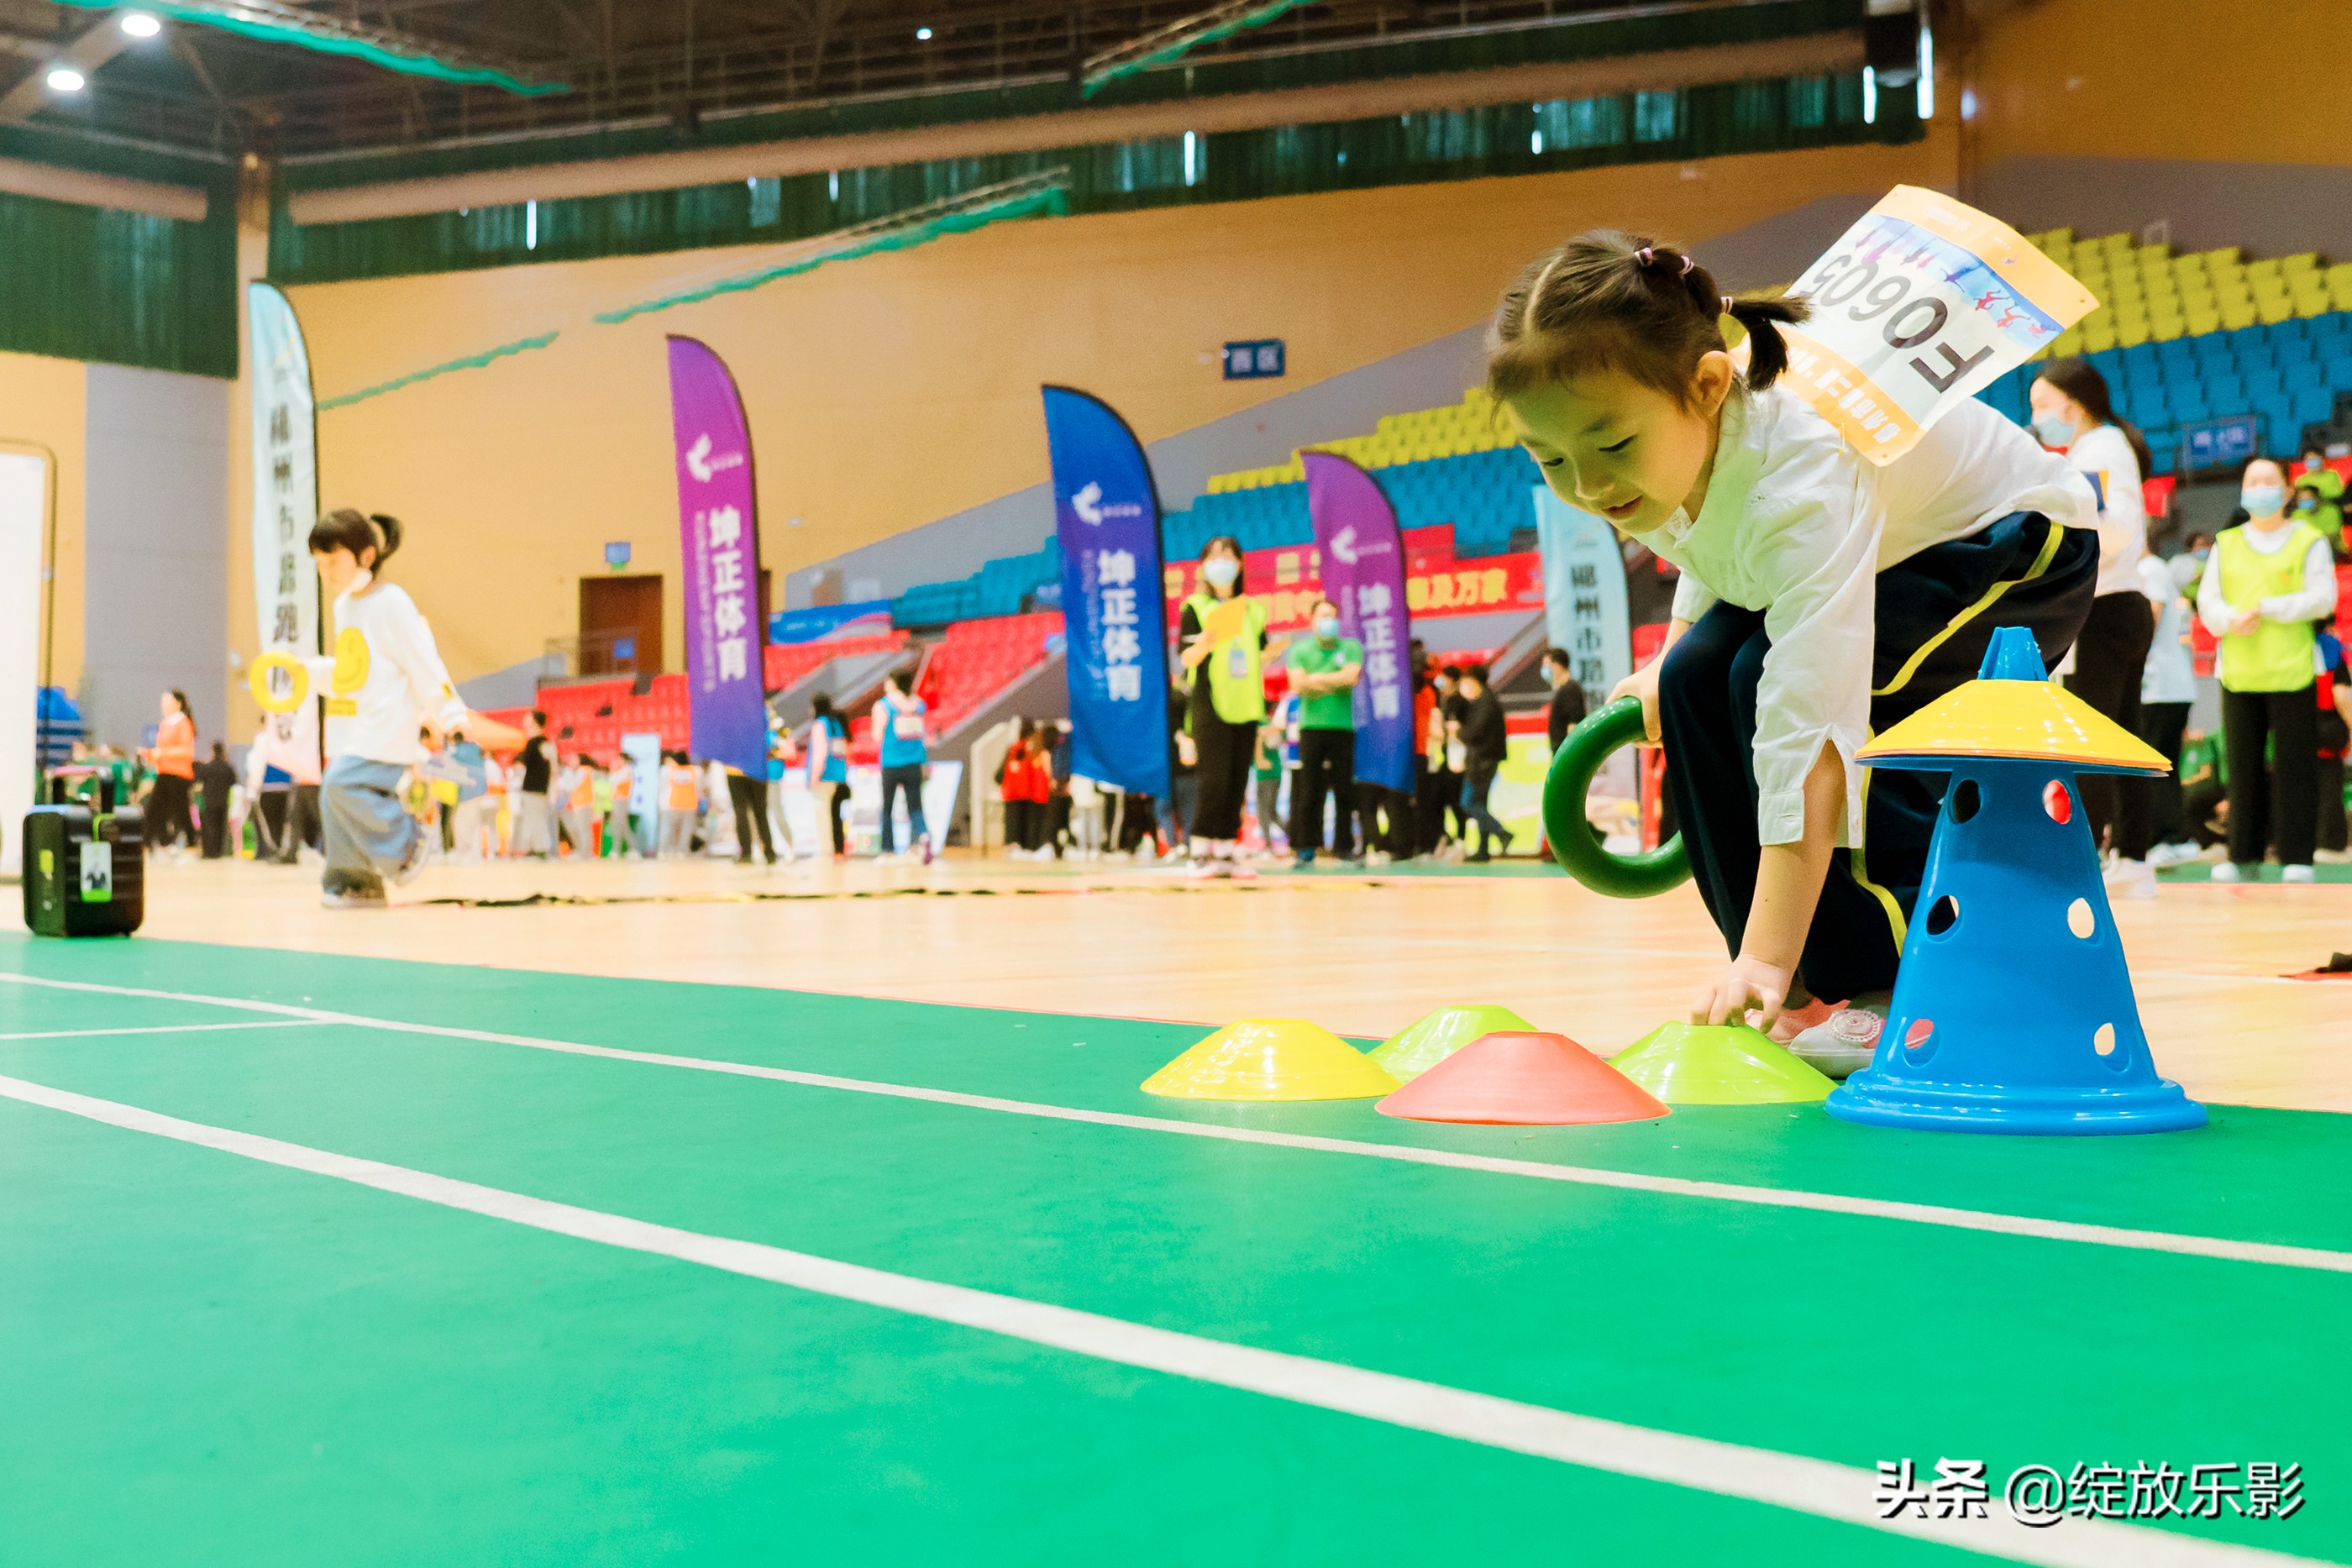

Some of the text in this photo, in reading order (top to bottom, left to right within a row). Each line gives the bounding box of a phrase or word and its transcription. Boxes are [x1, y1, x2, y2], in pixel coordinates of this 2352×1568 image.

[1802, 254, 1995, 393] F0605
[708, 503, 748, 683] 坤正体育
[1097, 548, 1142, 702] 坤正体育
[1357, 581, 1401, 721] 坤正体育
